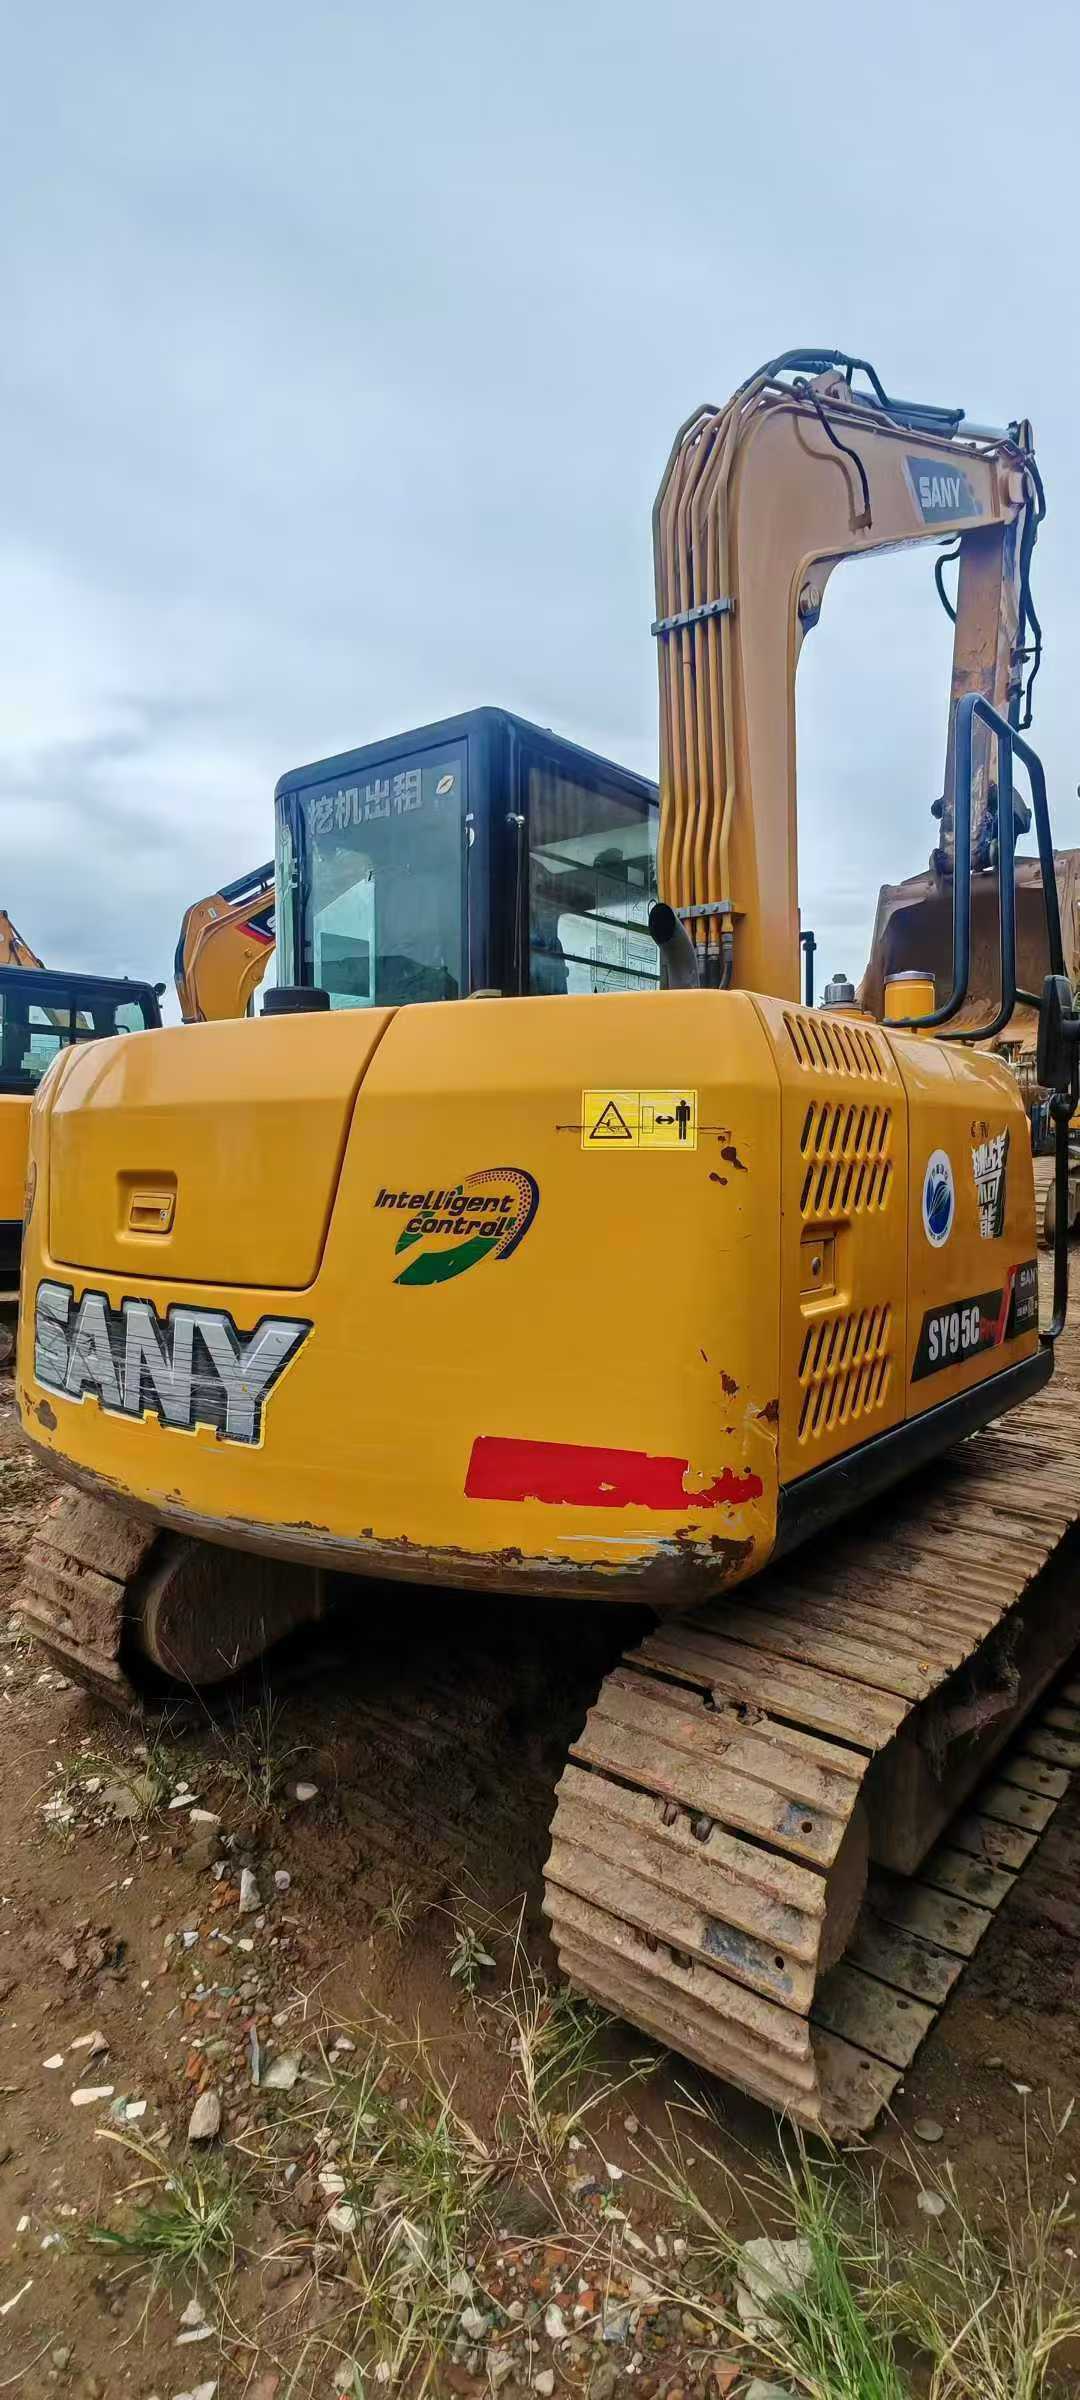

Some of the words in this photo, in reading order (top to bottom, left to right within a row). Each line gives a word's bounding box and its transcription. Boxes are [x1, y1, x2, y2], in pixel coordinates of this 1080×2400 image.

[920, 476, 960, 508] SANY
[308, 768, 423, 837] 挖机出租
[375, 1188, 514, 1217] Intelligent
[406, 1215, 507, 1237] control
[928, 1306, 980, 1361] SY95C
[34, 1279, 315, 1447] SANY
